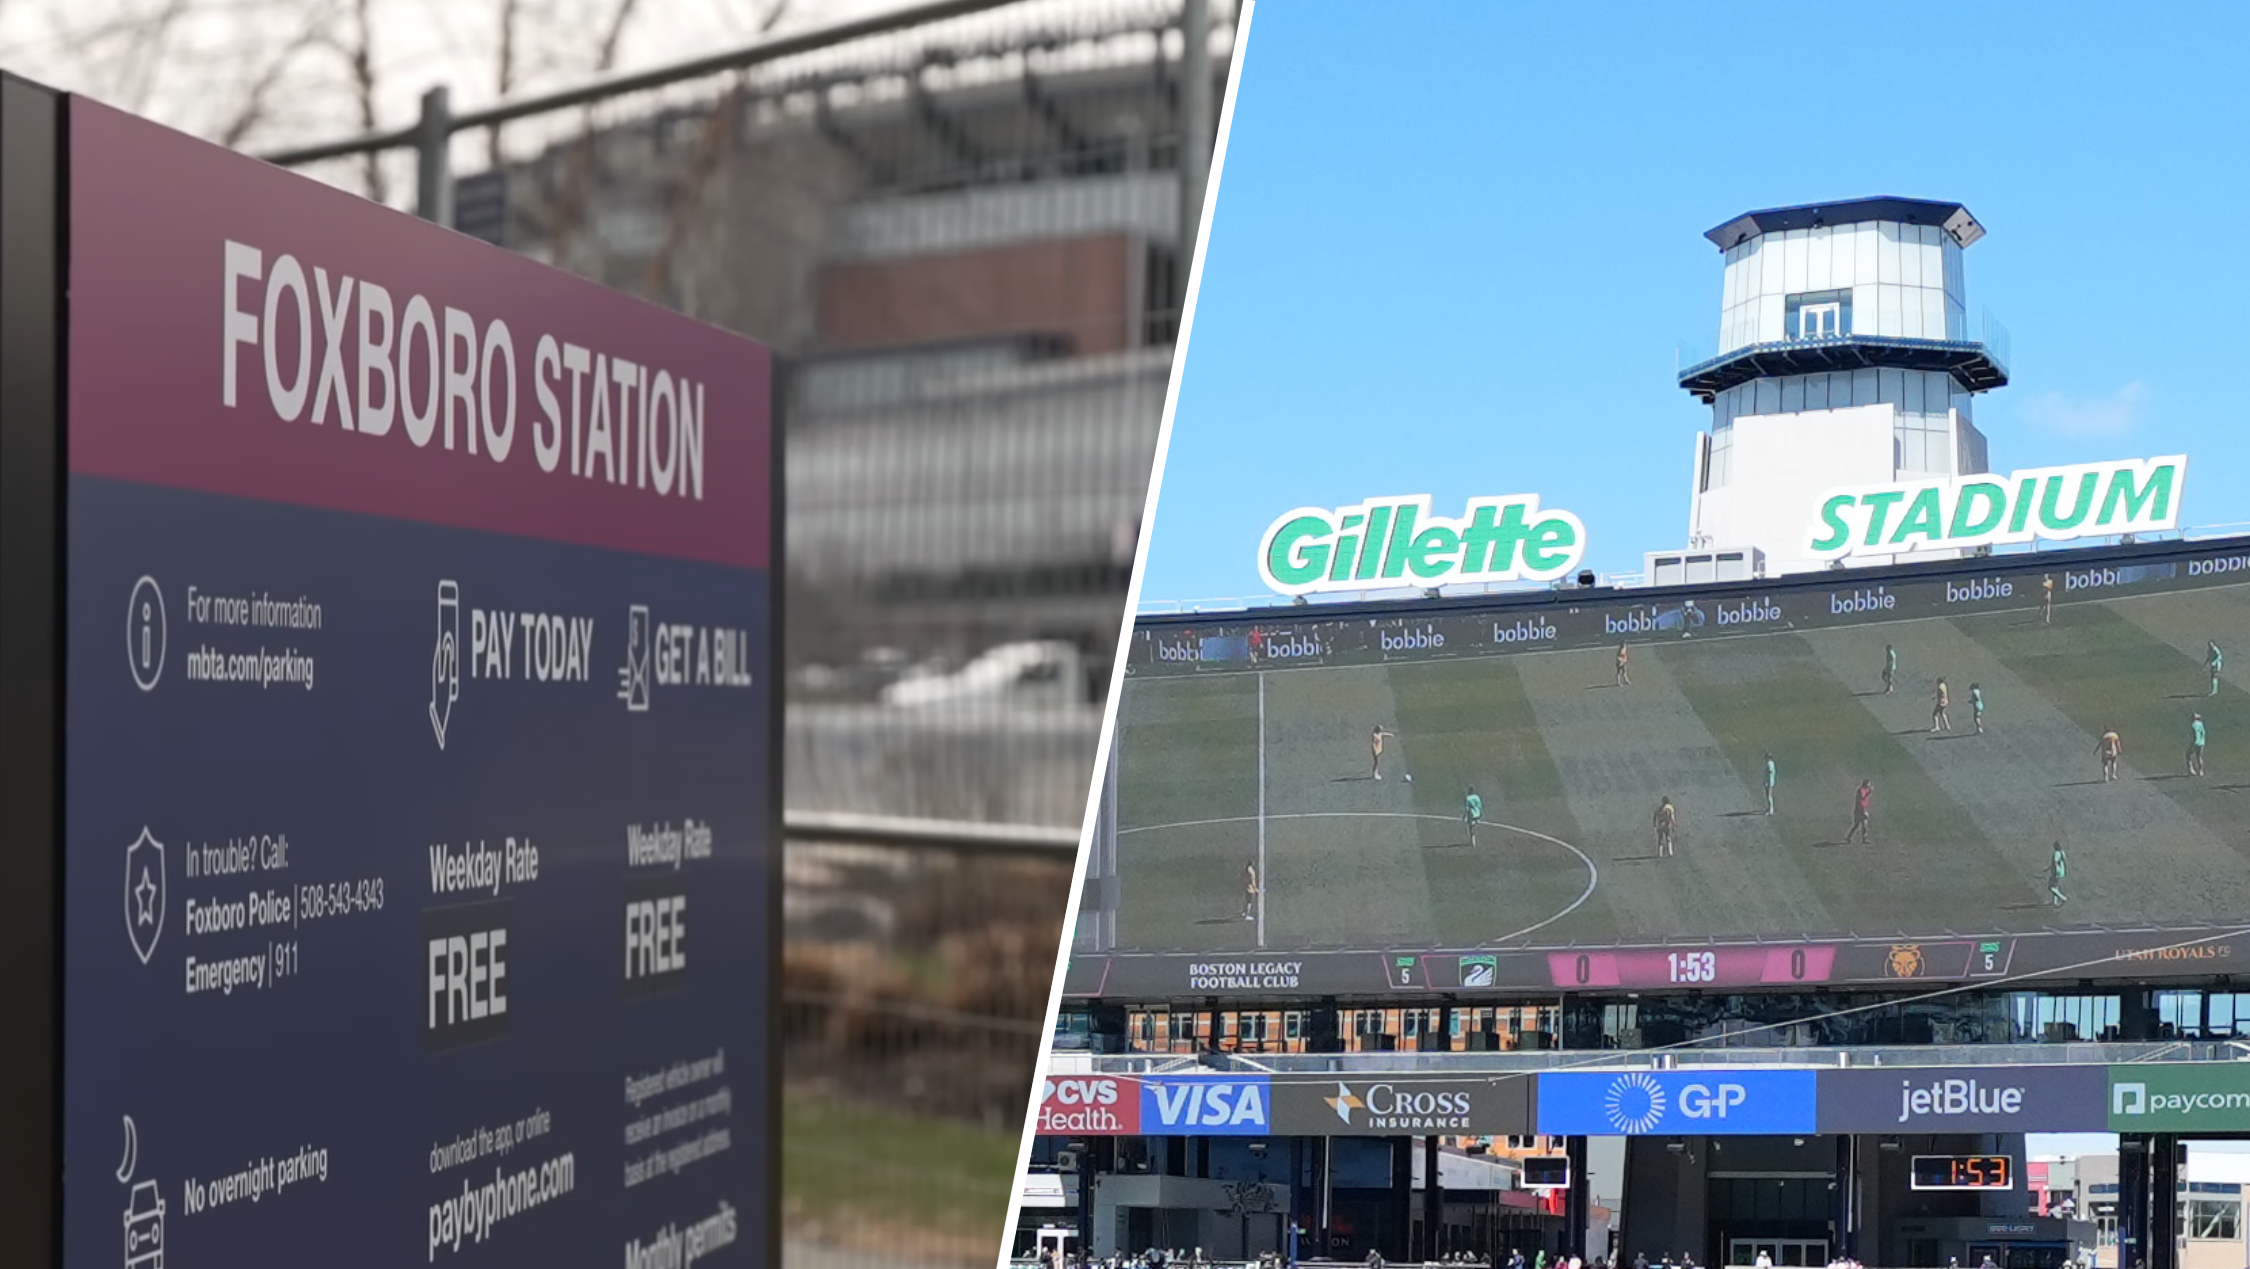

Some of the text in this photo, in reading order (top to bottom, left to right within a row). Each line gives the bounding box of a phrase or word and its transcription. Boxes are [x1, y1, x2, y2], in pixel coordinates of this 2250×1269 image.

[223, 239, 704, 500] FOXBORO STATION
[1811, 465, 2175, 551] STADIUM
[1266, 503, 1576, 585] Gillette
[188, 586, 322, 629] For more information
[1717, 596, 1781, 625] bobbie
[1831, 586, 1896, 614] bobbie
[1946, 577, 2013, 603] bobbie
[471, 609, 593, 682] PAY TODAY
[1381, 624, 1445, 651] bobbie
[1493, 616, 1556, 643] bobbie
[187, 644, 314, 691] mbta.com/parking
[655, 622, 751, 686] GET A BILL
[186, 834, 289, 878] In trouble? Call:
[627, 818, 712, 870] Weekday Rate
[429, 837, 539, 896] Weekday Rate
[186, 877, 384, 936] Foxboro Police 508-543-4343
[625, 895, 686, 979] FREE
[2159, 945, 2216, 960] ROYALS
[186, 940, 298, 995] Emergency 911
[429, 928, 507, 1029] FREE
[1190, 962, 1302, 976] BOSTON LEGACY
[1191, 975, 1299, 989] FOOTBALL CLUB
[1401, 968, 1410, 984] 5
[1576, 954, 1590, 984] 0
[1668, 951, 1716, 982] 1:53
[1791, 950, 1805, 979] 0
[1985, 954, 1994, 970] 5
[1057, 1080, 1118, 1105] CVS
[1144, 1084, 1265, 1126] VISA
[1899, 1079, 2022, 1122] jetBlue
[2150, 1093, 2250, 1114] paycom
[430, 1106, 551, 1174] download the app, or online
[1369, 1117, 1470, 1128] INSURANCE
[184, 1144, 328, 1216] No overnight parking
[1951, 1156, 2006, 1187] 1:53
[429, 1151, 575, 1263] paybyphone.com
